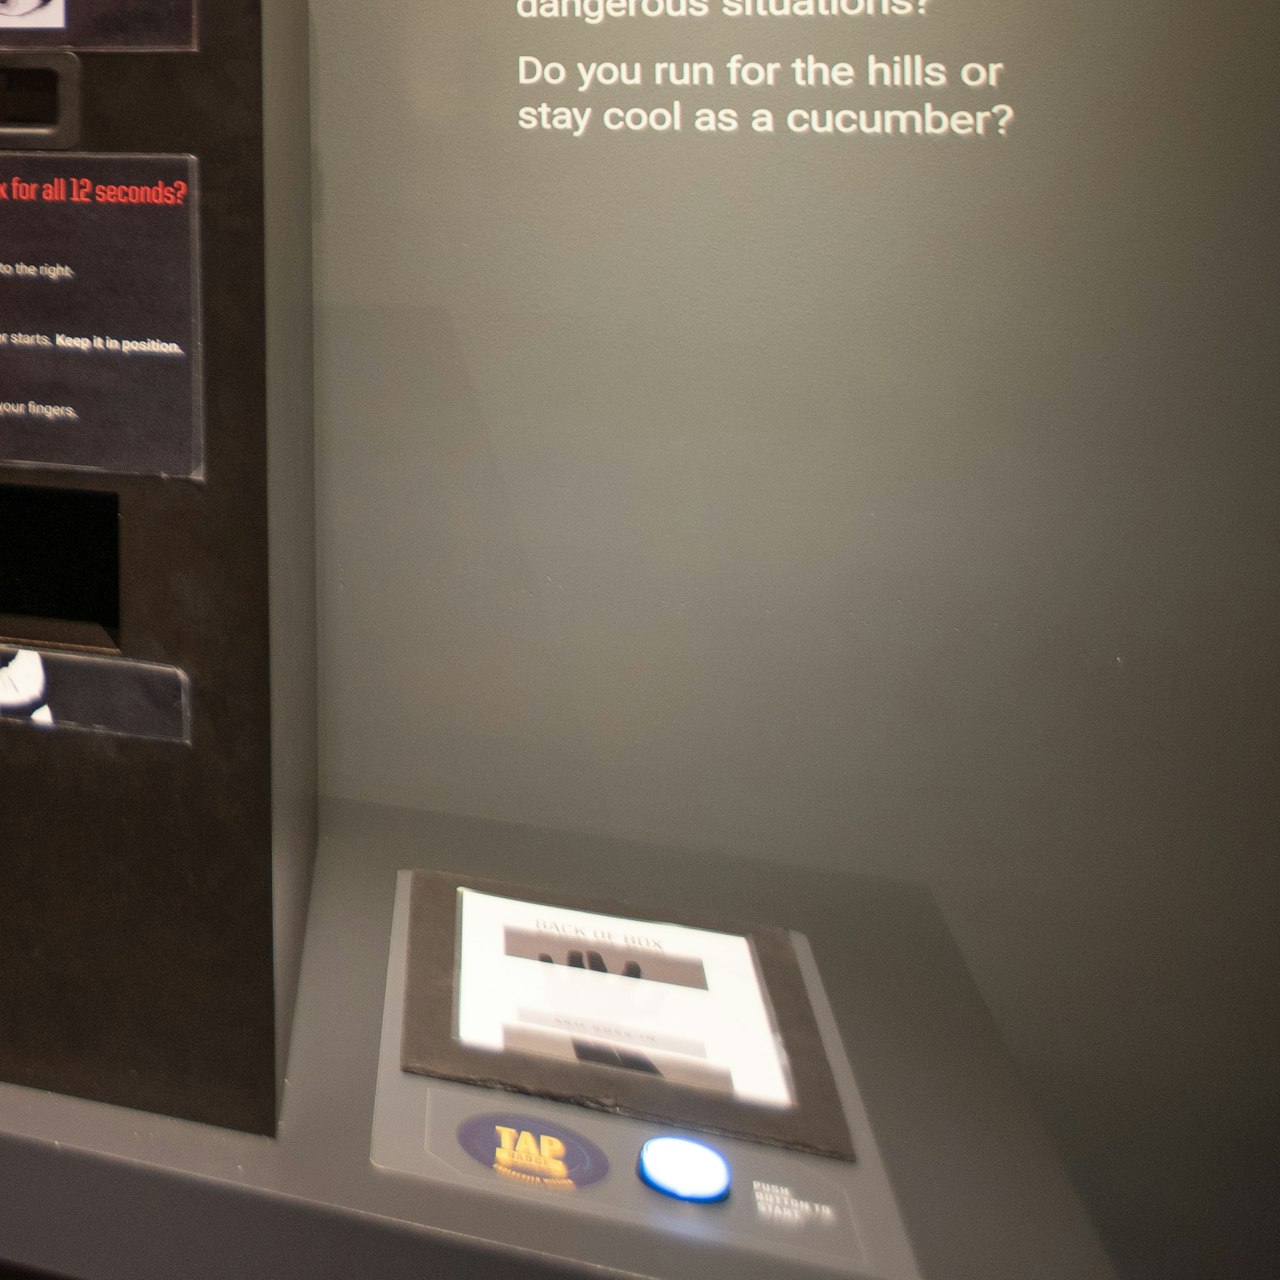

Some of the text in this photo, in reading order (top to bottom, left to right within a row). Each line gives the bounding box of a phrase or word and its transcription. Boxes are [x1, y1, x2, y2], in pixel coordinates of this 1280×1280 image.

[518, 55, 1003, 92] Do you run for the hills or
[518, 100, 1014, 137] stay cool as a cucumber?
[12, 177, 37, 200] for
[42, 178, 65, 201] all
[70, 178, 92, 202] 12
[96, 180, 188, 204] seconds?
[0, 262, 12, 274] to
[15, 262, 37, 274] the
[40, 264, 74, 280] right.
[10, 331, 51, 346] starts.
[55, 334, 91, 350] Keep
[93, 335, 106, 349] it
[106, 337, 120, 350] in
[122, 338, 183, 355] position.
[28, 401, 77, 417] fingers.
[495, 1125, 566, 1160] TAP
[753, 1181, 789, 1196] PUSH
[755, 1191, 831, 1214] BUTTON TO
[757, 1202, 800, 1217] START
